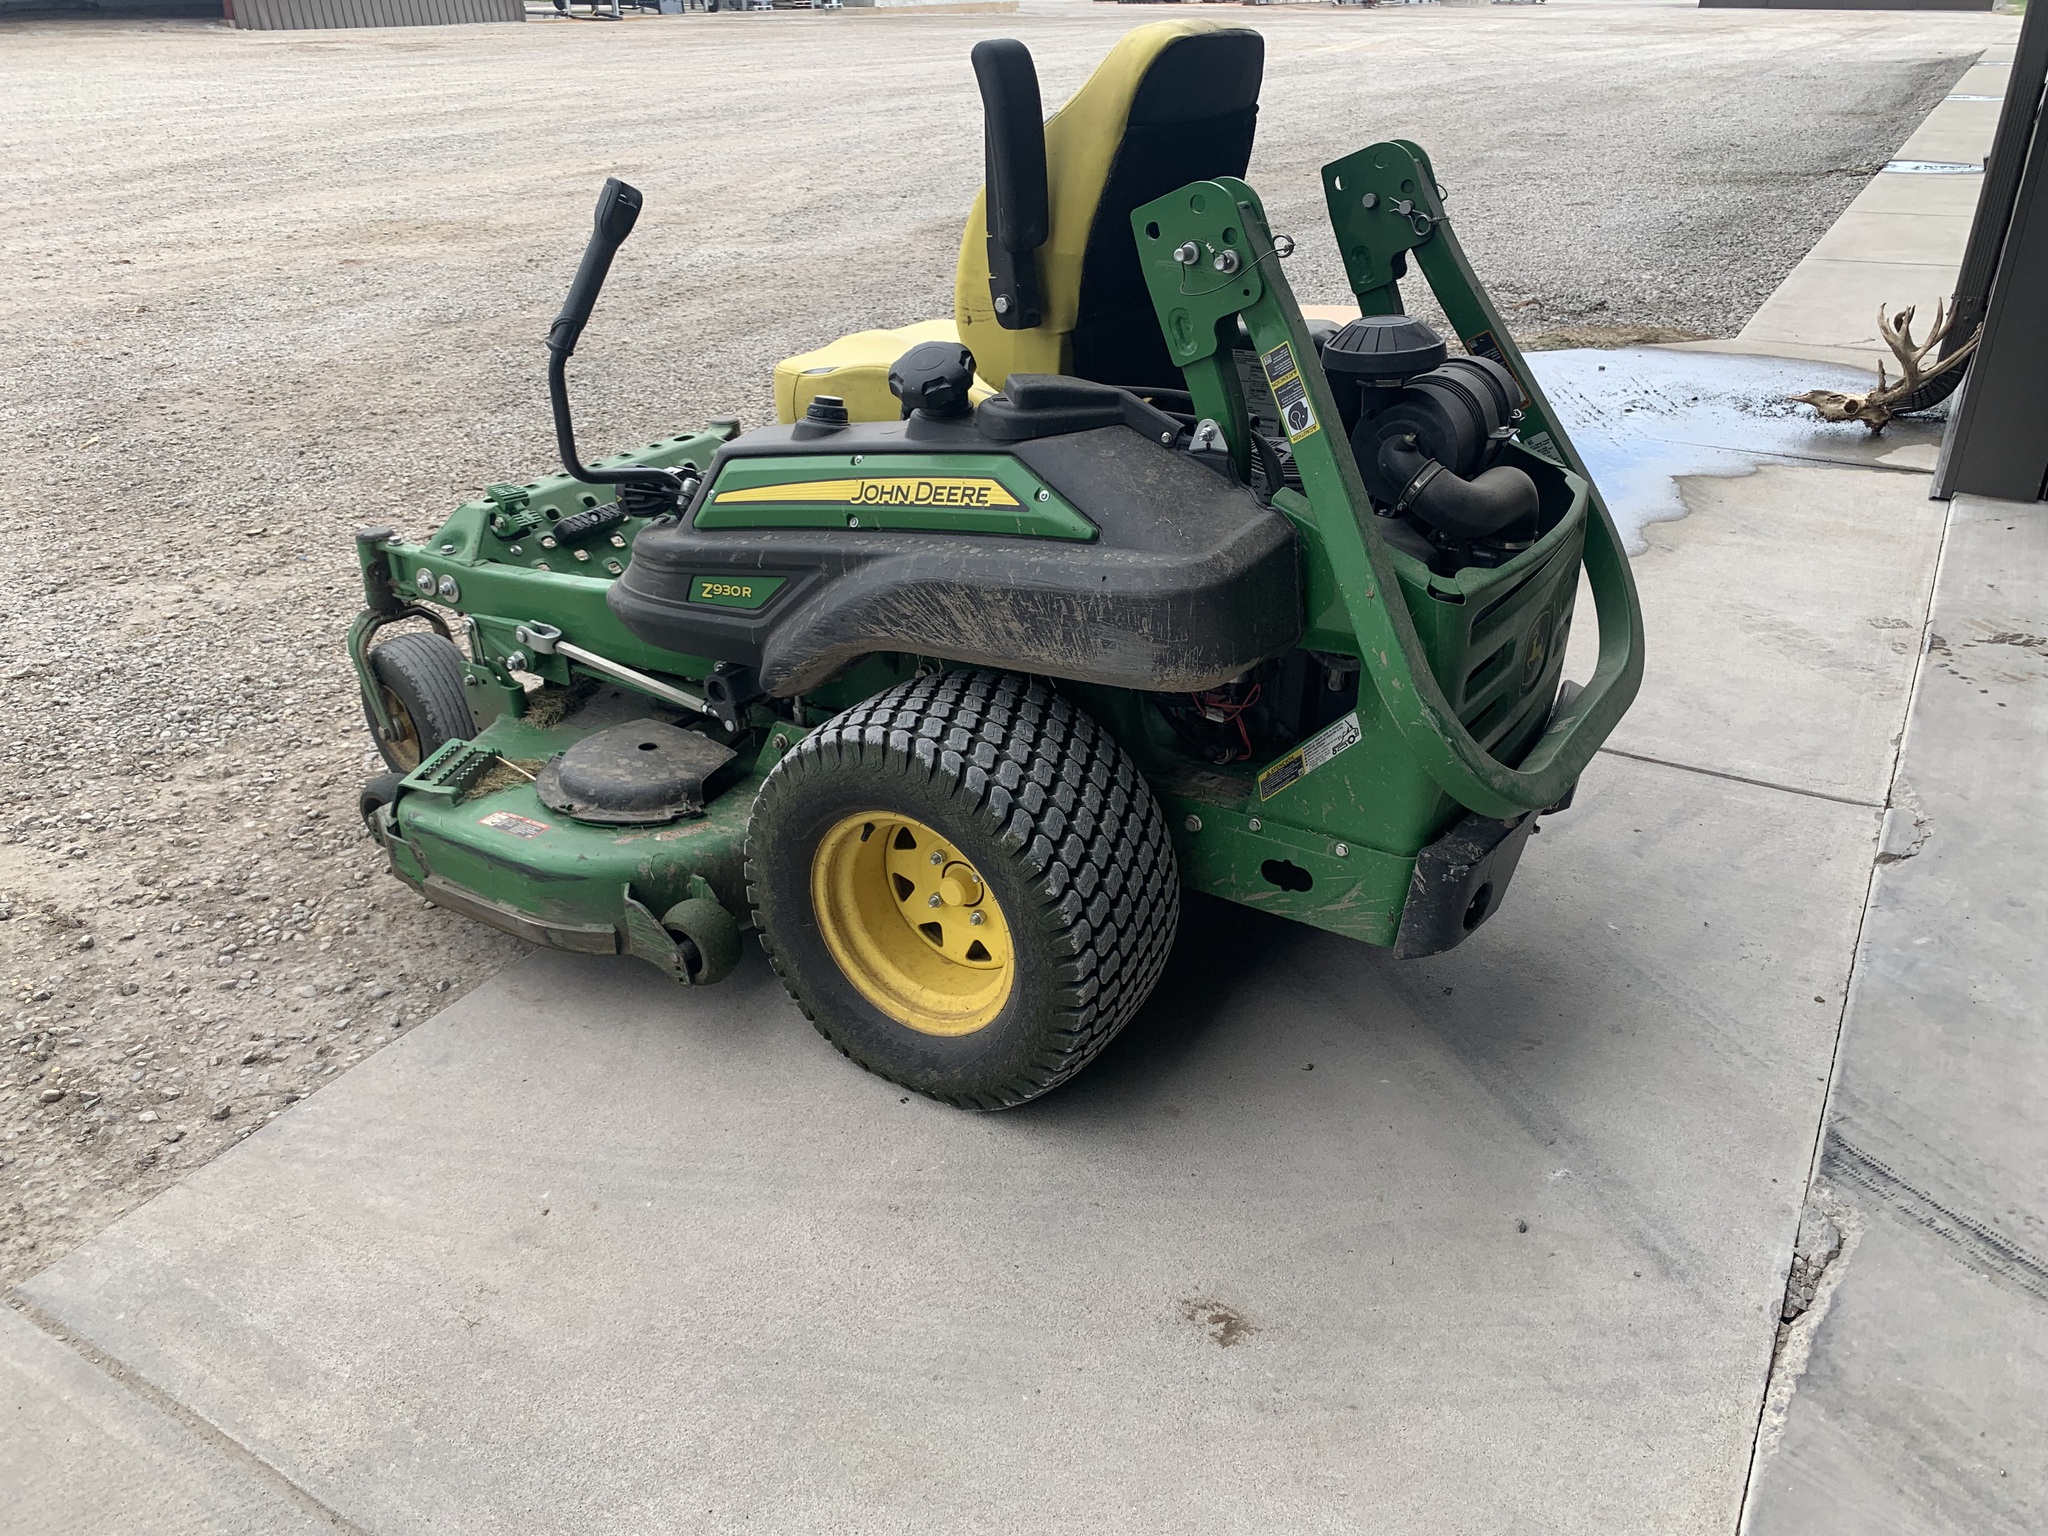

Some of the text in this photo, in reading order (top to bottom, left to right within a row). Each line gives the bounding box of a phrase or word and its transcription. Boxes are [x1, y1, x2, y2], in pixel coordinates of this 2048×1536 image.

[1293, 427, 1314, 442] CAUTION
[850, 481, 991, 506] JOHN DEERE
[701, 582, 752, 598] Z930R
